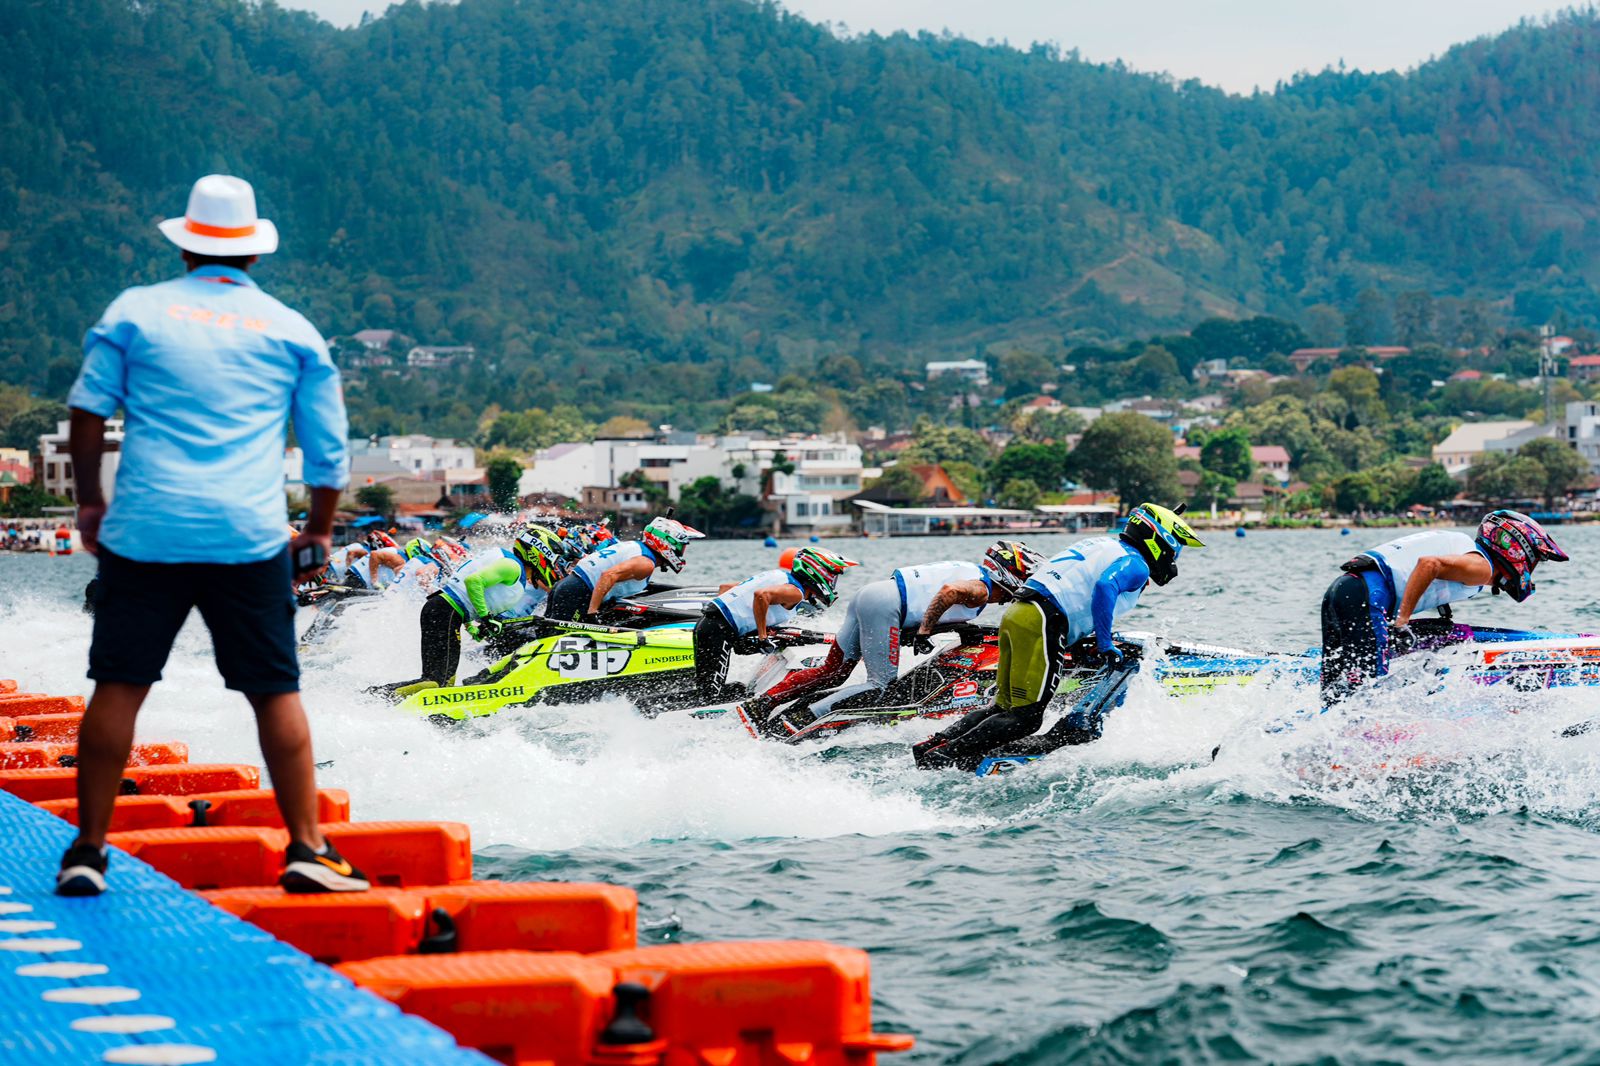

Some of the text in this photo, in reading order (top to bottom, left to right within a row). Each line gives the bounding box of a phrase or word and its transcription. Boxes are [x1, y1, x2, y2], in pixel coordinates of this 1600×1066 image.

[167, 304, 272, 332] CREW
[598, 549, 617, 560] 4
[1050, 549, 1086, 563] 7
[422, 685, 524, 706] LINDBERGH
